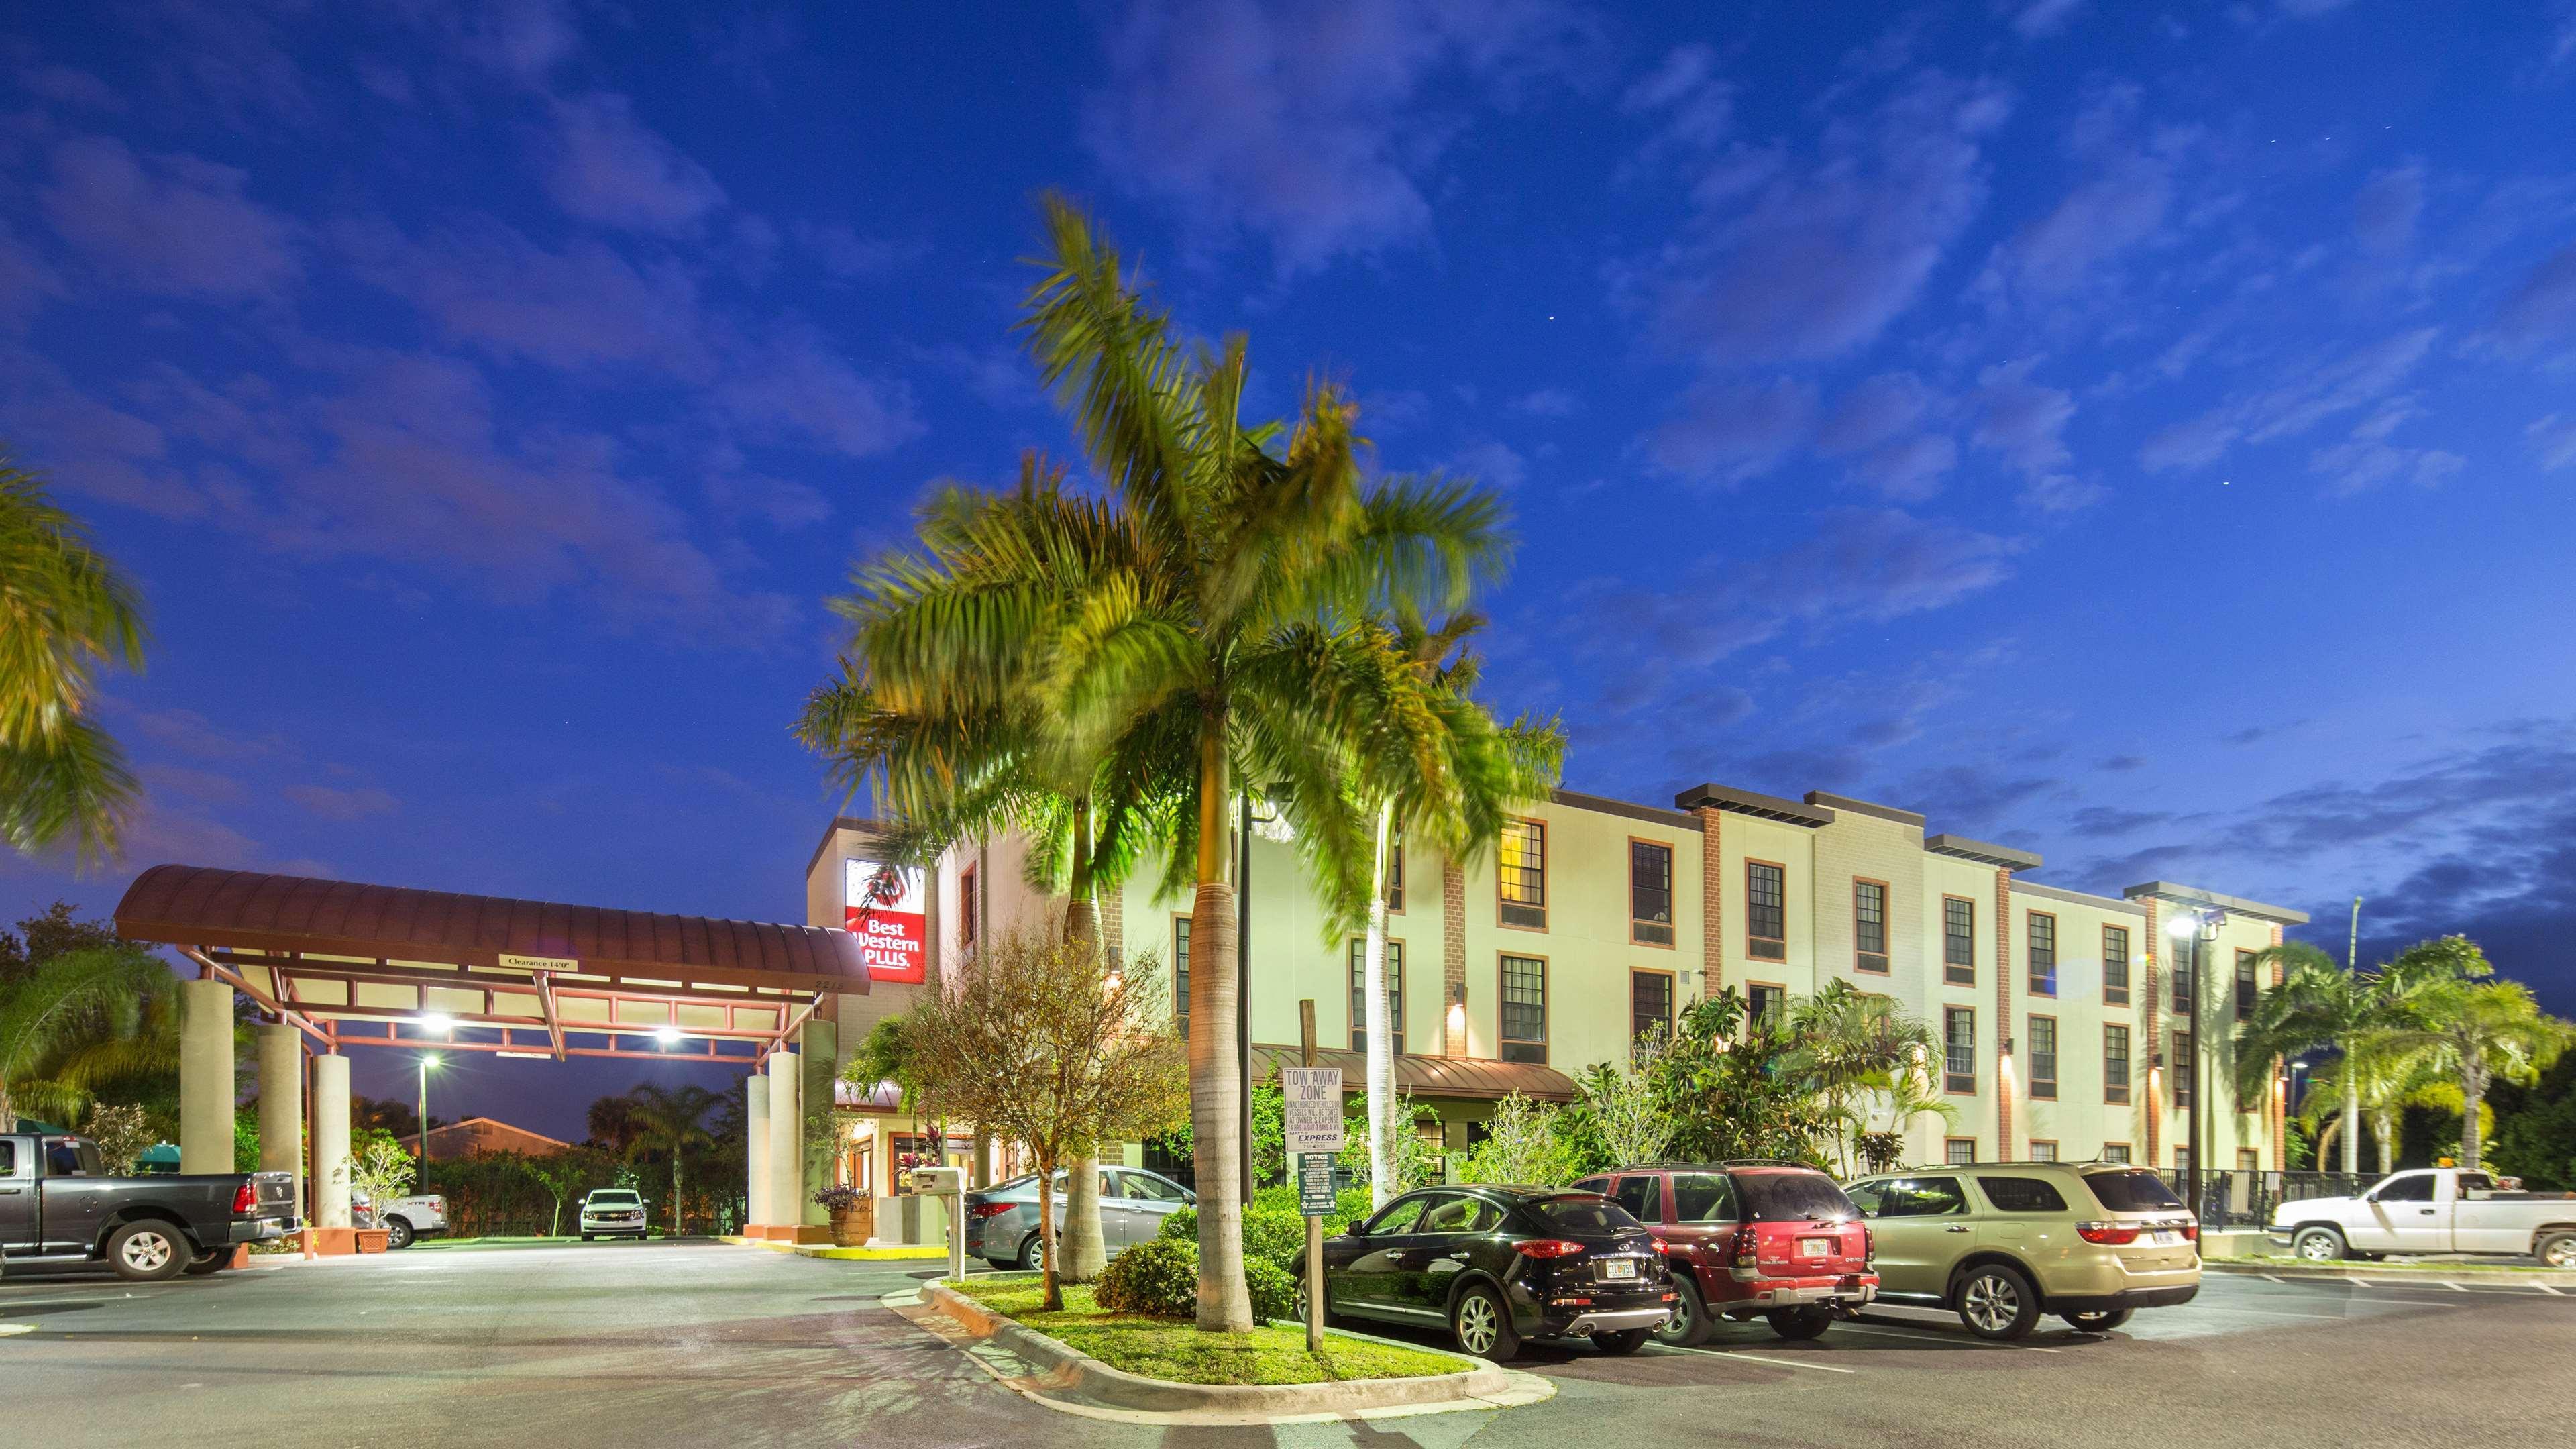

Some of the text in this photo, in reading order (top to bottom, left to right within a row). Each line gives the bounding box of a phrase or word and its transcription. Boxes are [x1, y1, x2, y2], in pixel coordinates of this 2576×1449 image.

[869, 919, 905, 936] Best
[852, 931, 919, 952] Western
[508, 958, 547, 967] Clearance
[1286, 1071, 1339, 1085] TOW AWAY
[1301, 1085, 1326, 1100] ZONE
[1289, 1108, 1307, 1116] VESSELS
[1308, 1108, 1318, 1116] WILL
